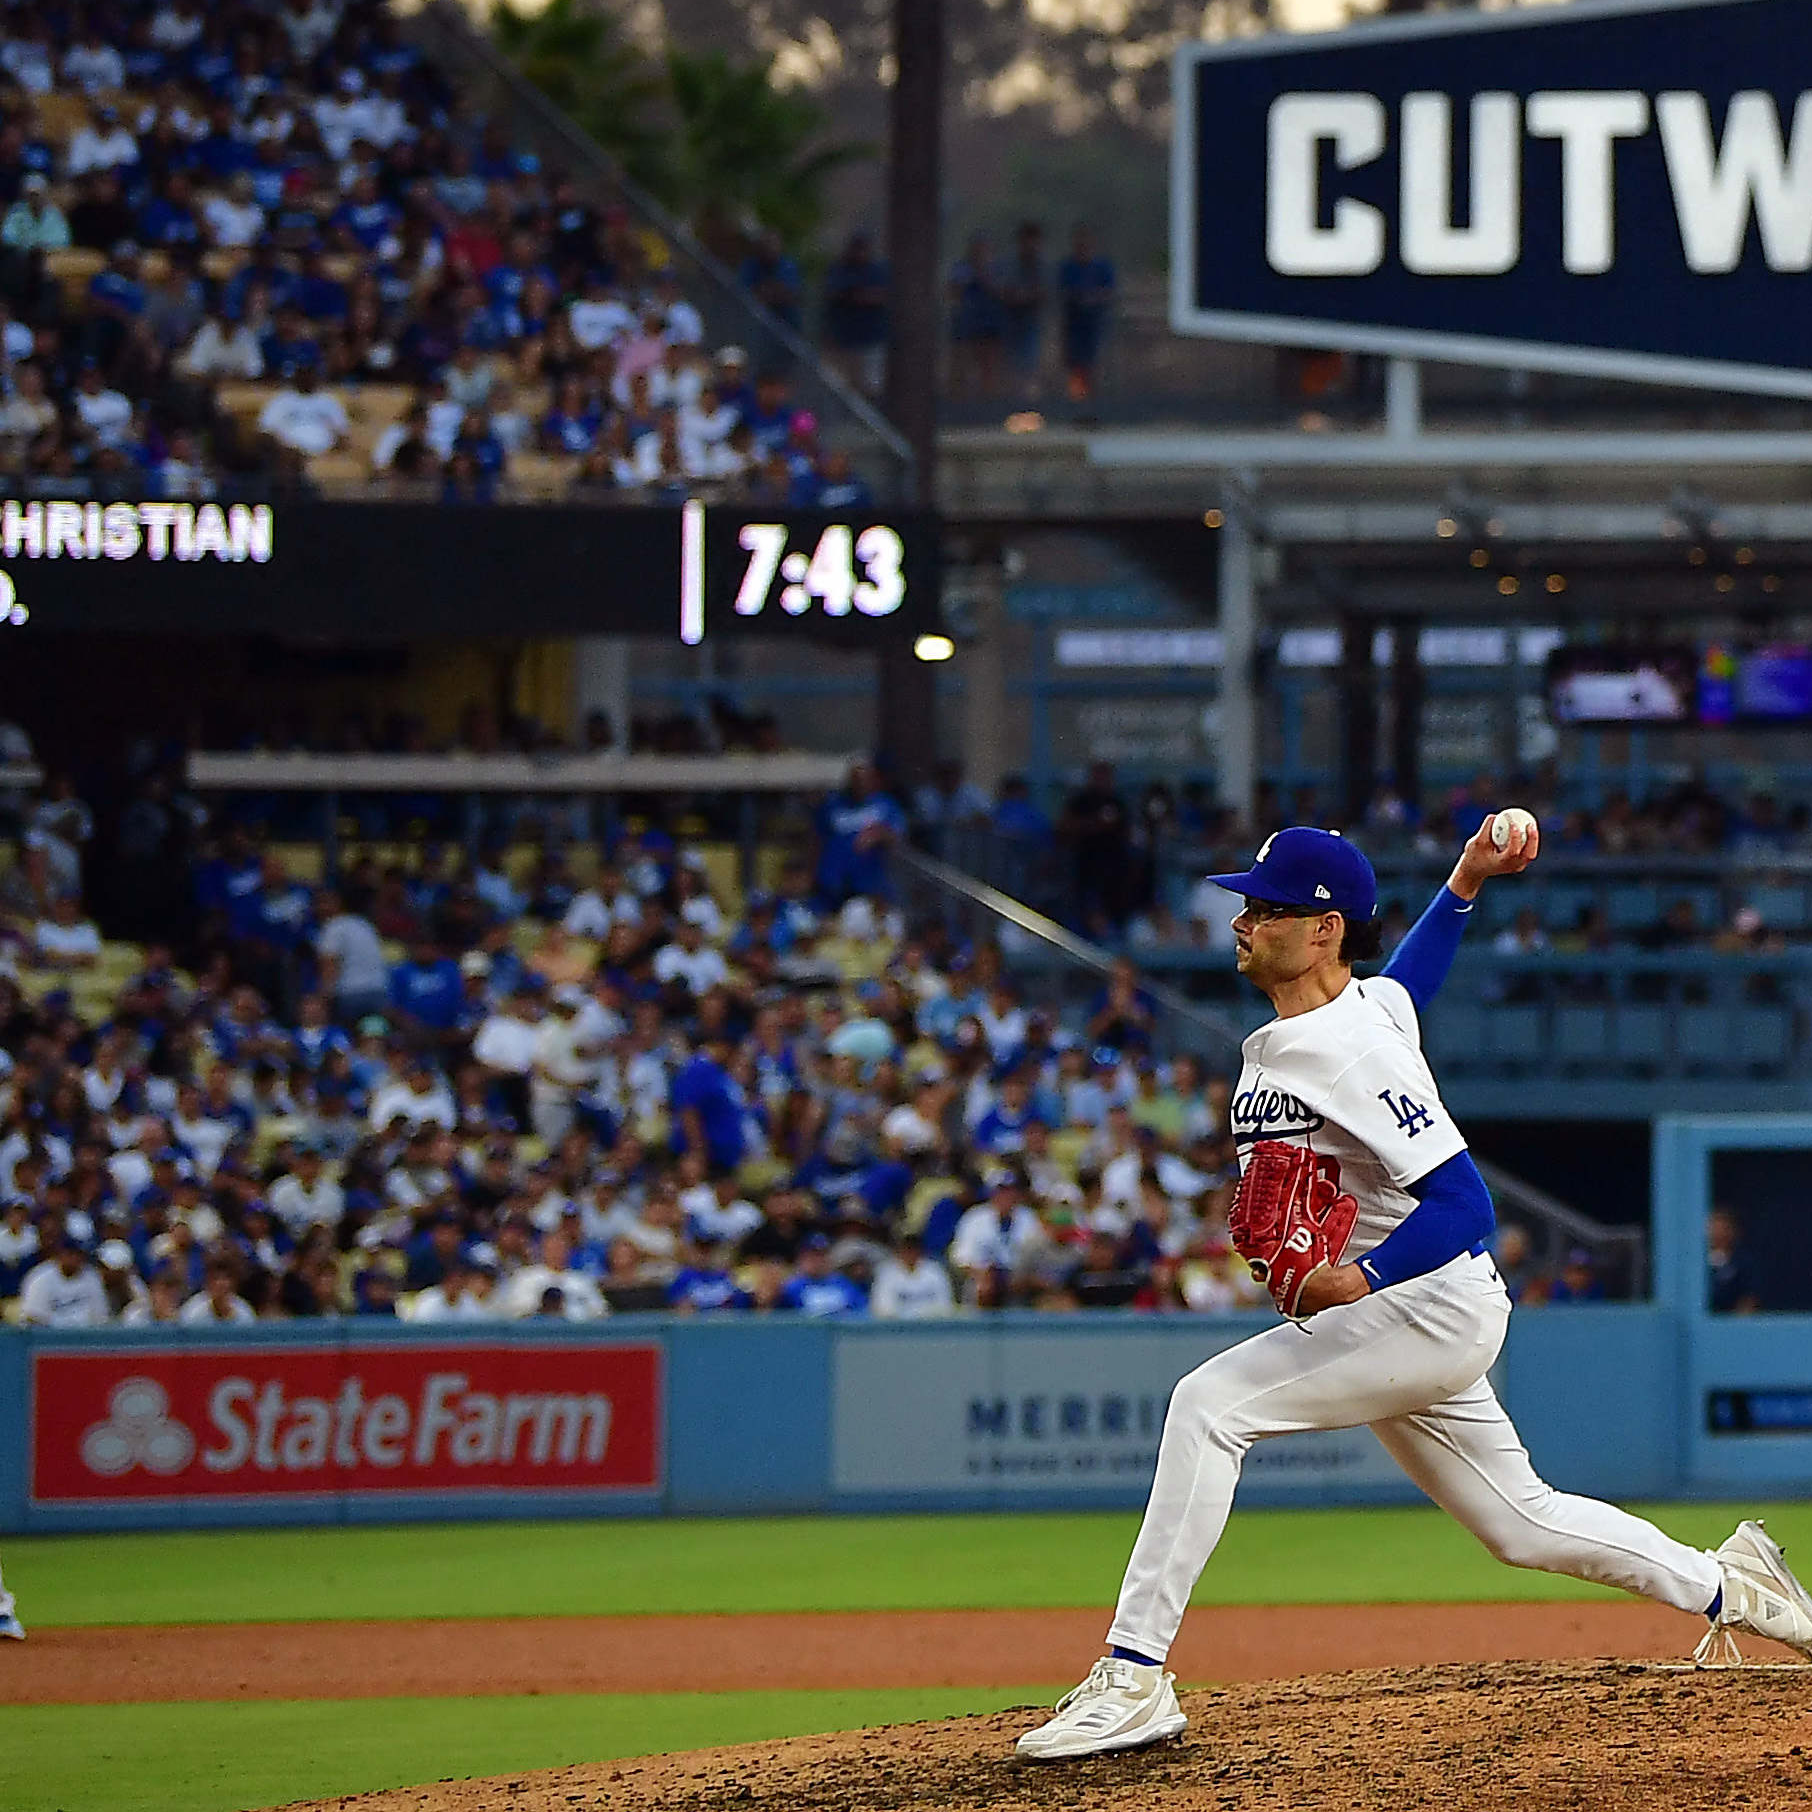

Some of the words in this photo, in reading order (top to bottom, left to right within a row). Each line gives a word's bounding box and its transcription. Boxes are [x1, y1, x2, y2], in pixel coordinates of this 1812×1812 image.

[0, 499, 273, 564] HRISTIAN
[734, 523, 907, 617] 7:43
[1230, 1072, 1322, 1126] dgers
[1378, 1089, 1435, 1139] LA
